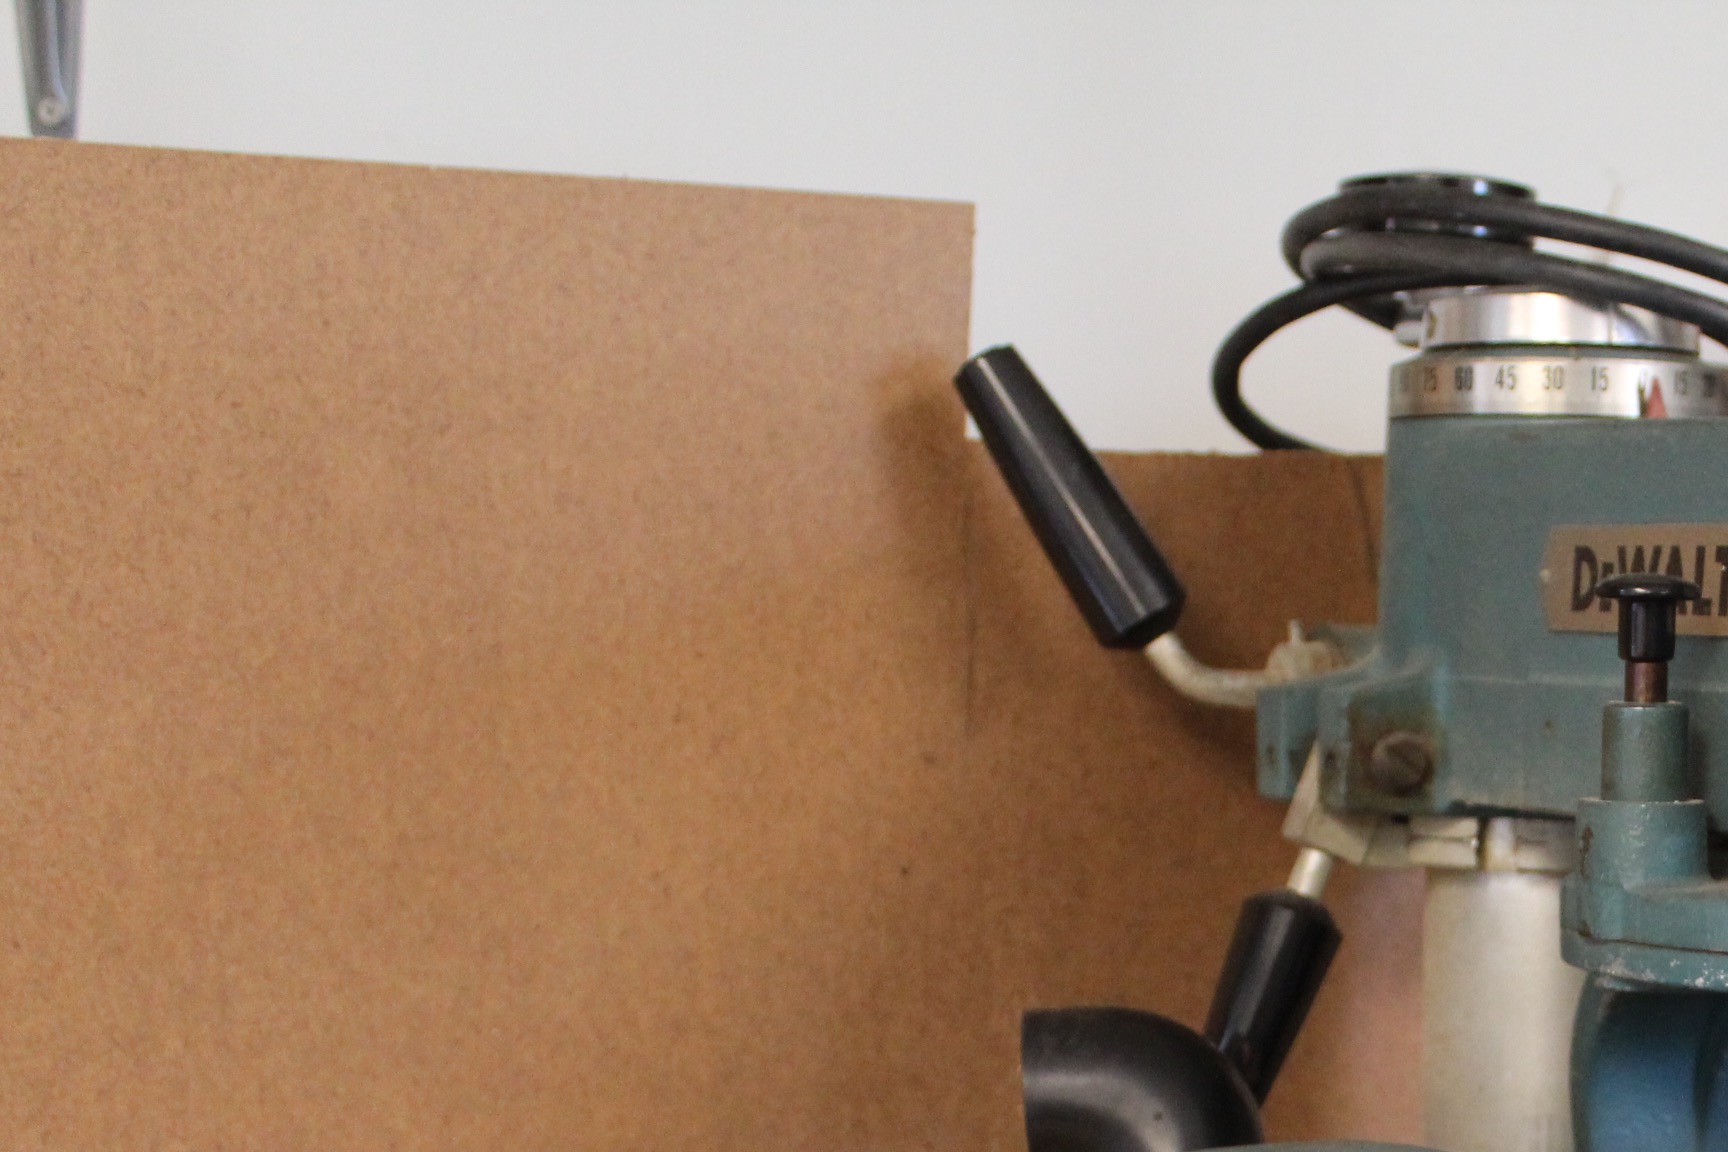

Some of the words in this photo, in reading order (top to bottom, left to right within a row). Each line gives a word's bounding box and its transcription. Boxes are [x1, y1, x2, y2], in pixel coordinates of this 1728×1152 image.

[1454, 366, 1473, 391] 60
[1495, 365, 1517, 390] 45
[1543, 365, 1565, 390] 30
[1591, 366, 1609, 391] 15
